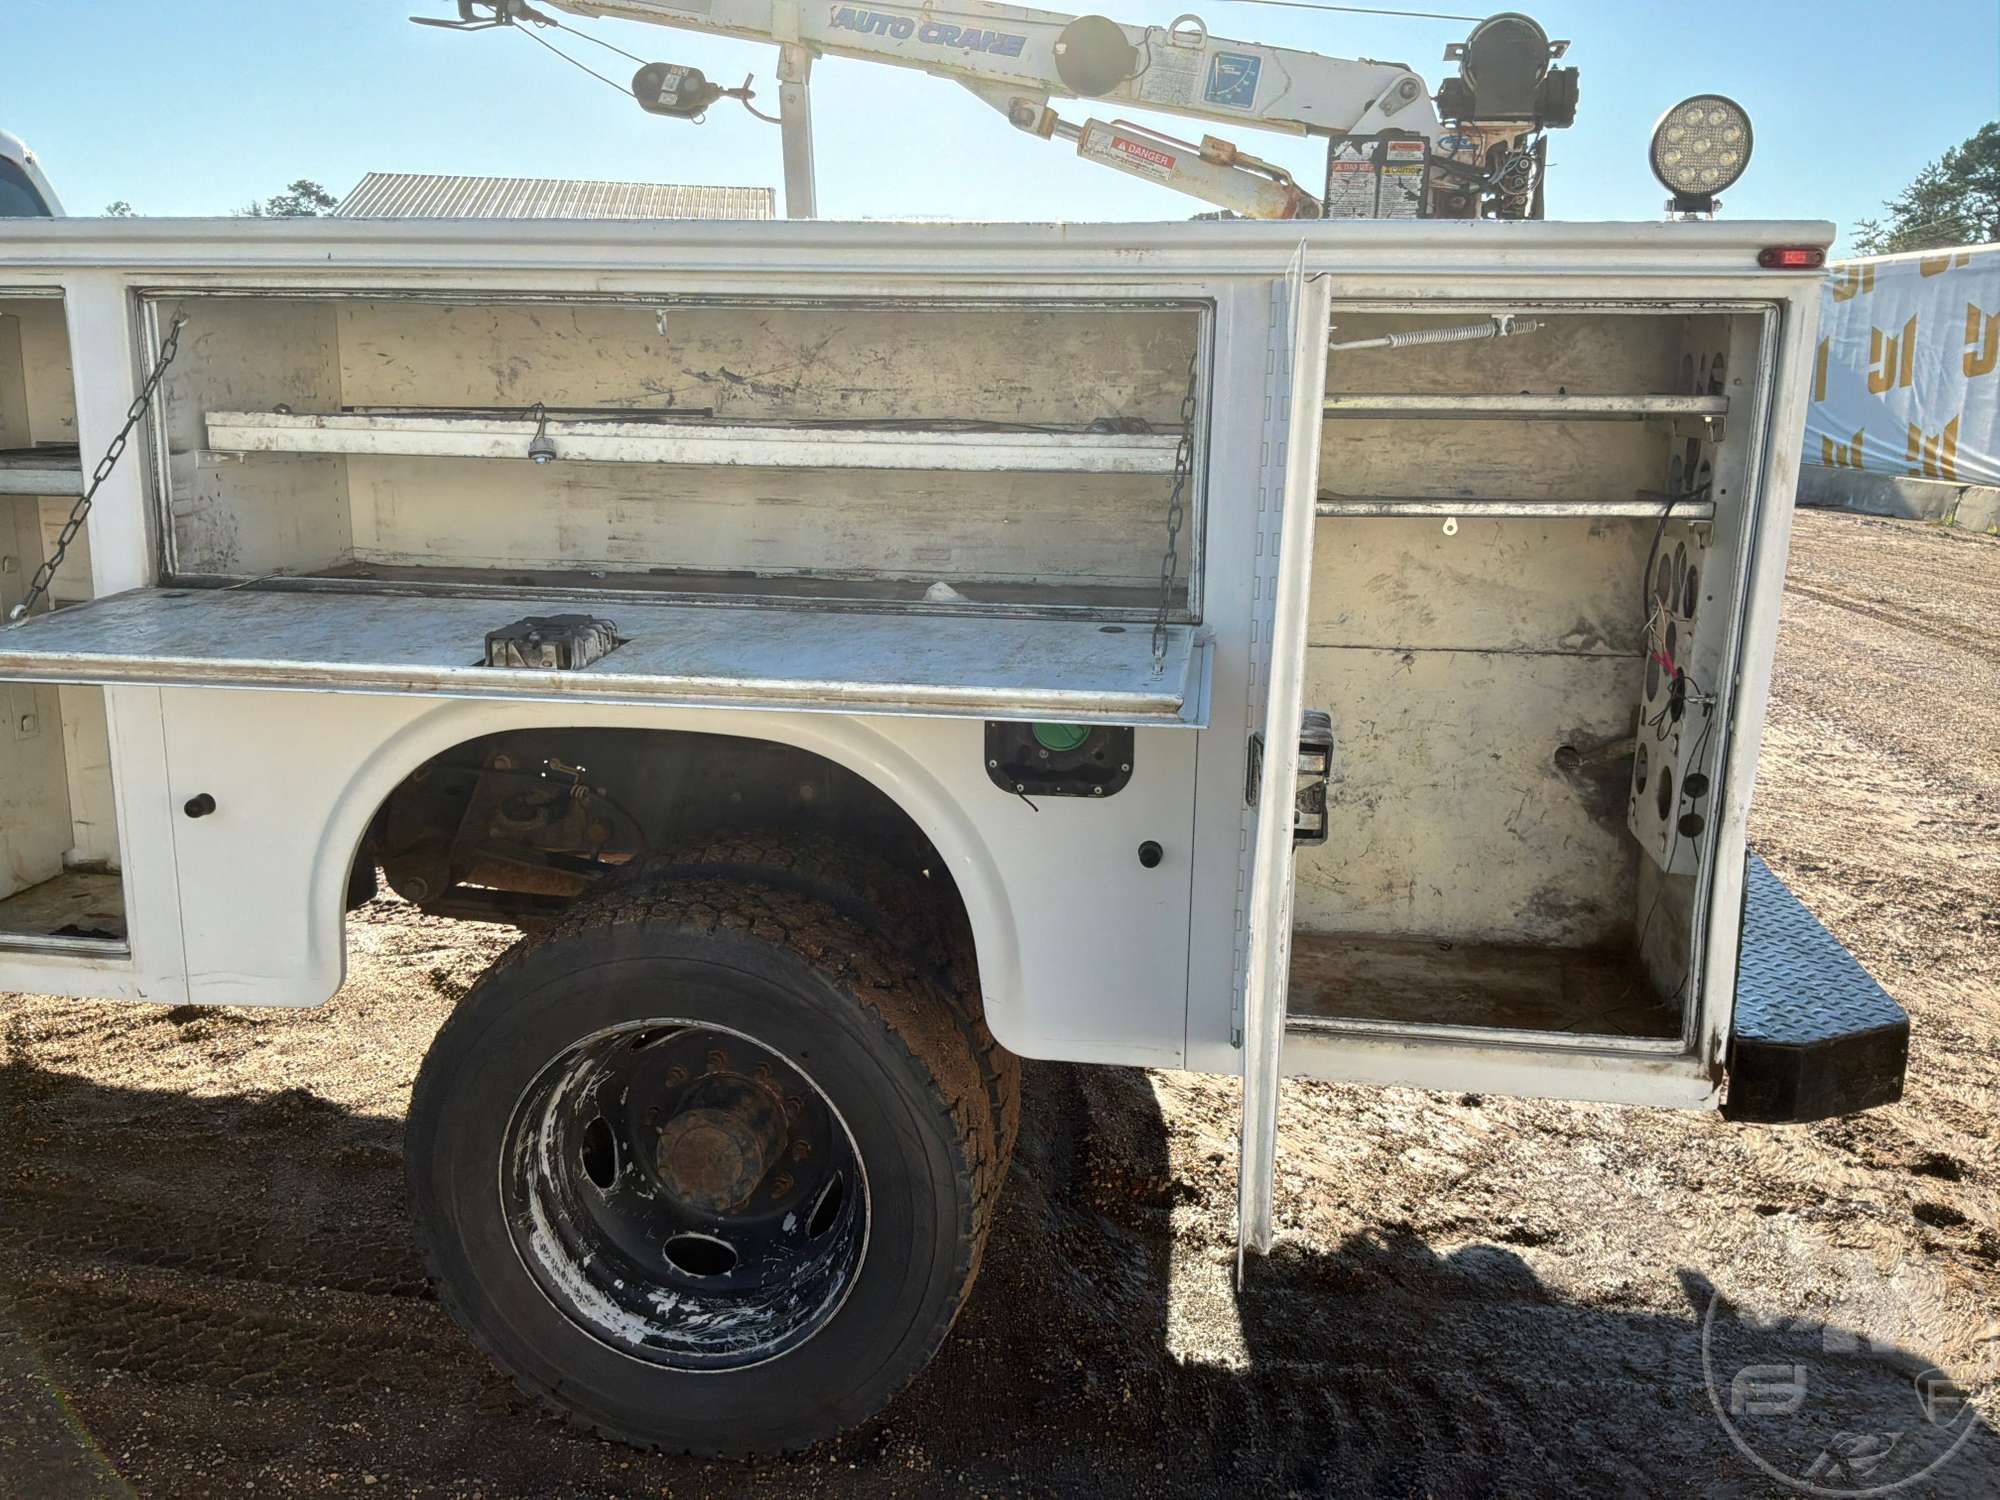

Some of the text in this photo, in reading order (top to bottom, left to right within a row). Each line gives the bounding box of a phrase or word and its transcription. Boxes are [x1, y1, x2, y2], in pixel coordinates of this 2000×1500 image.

[834, 7, 1028, 58] AUTO CRANE
[1127, 143, 1169, 166] DANGER
